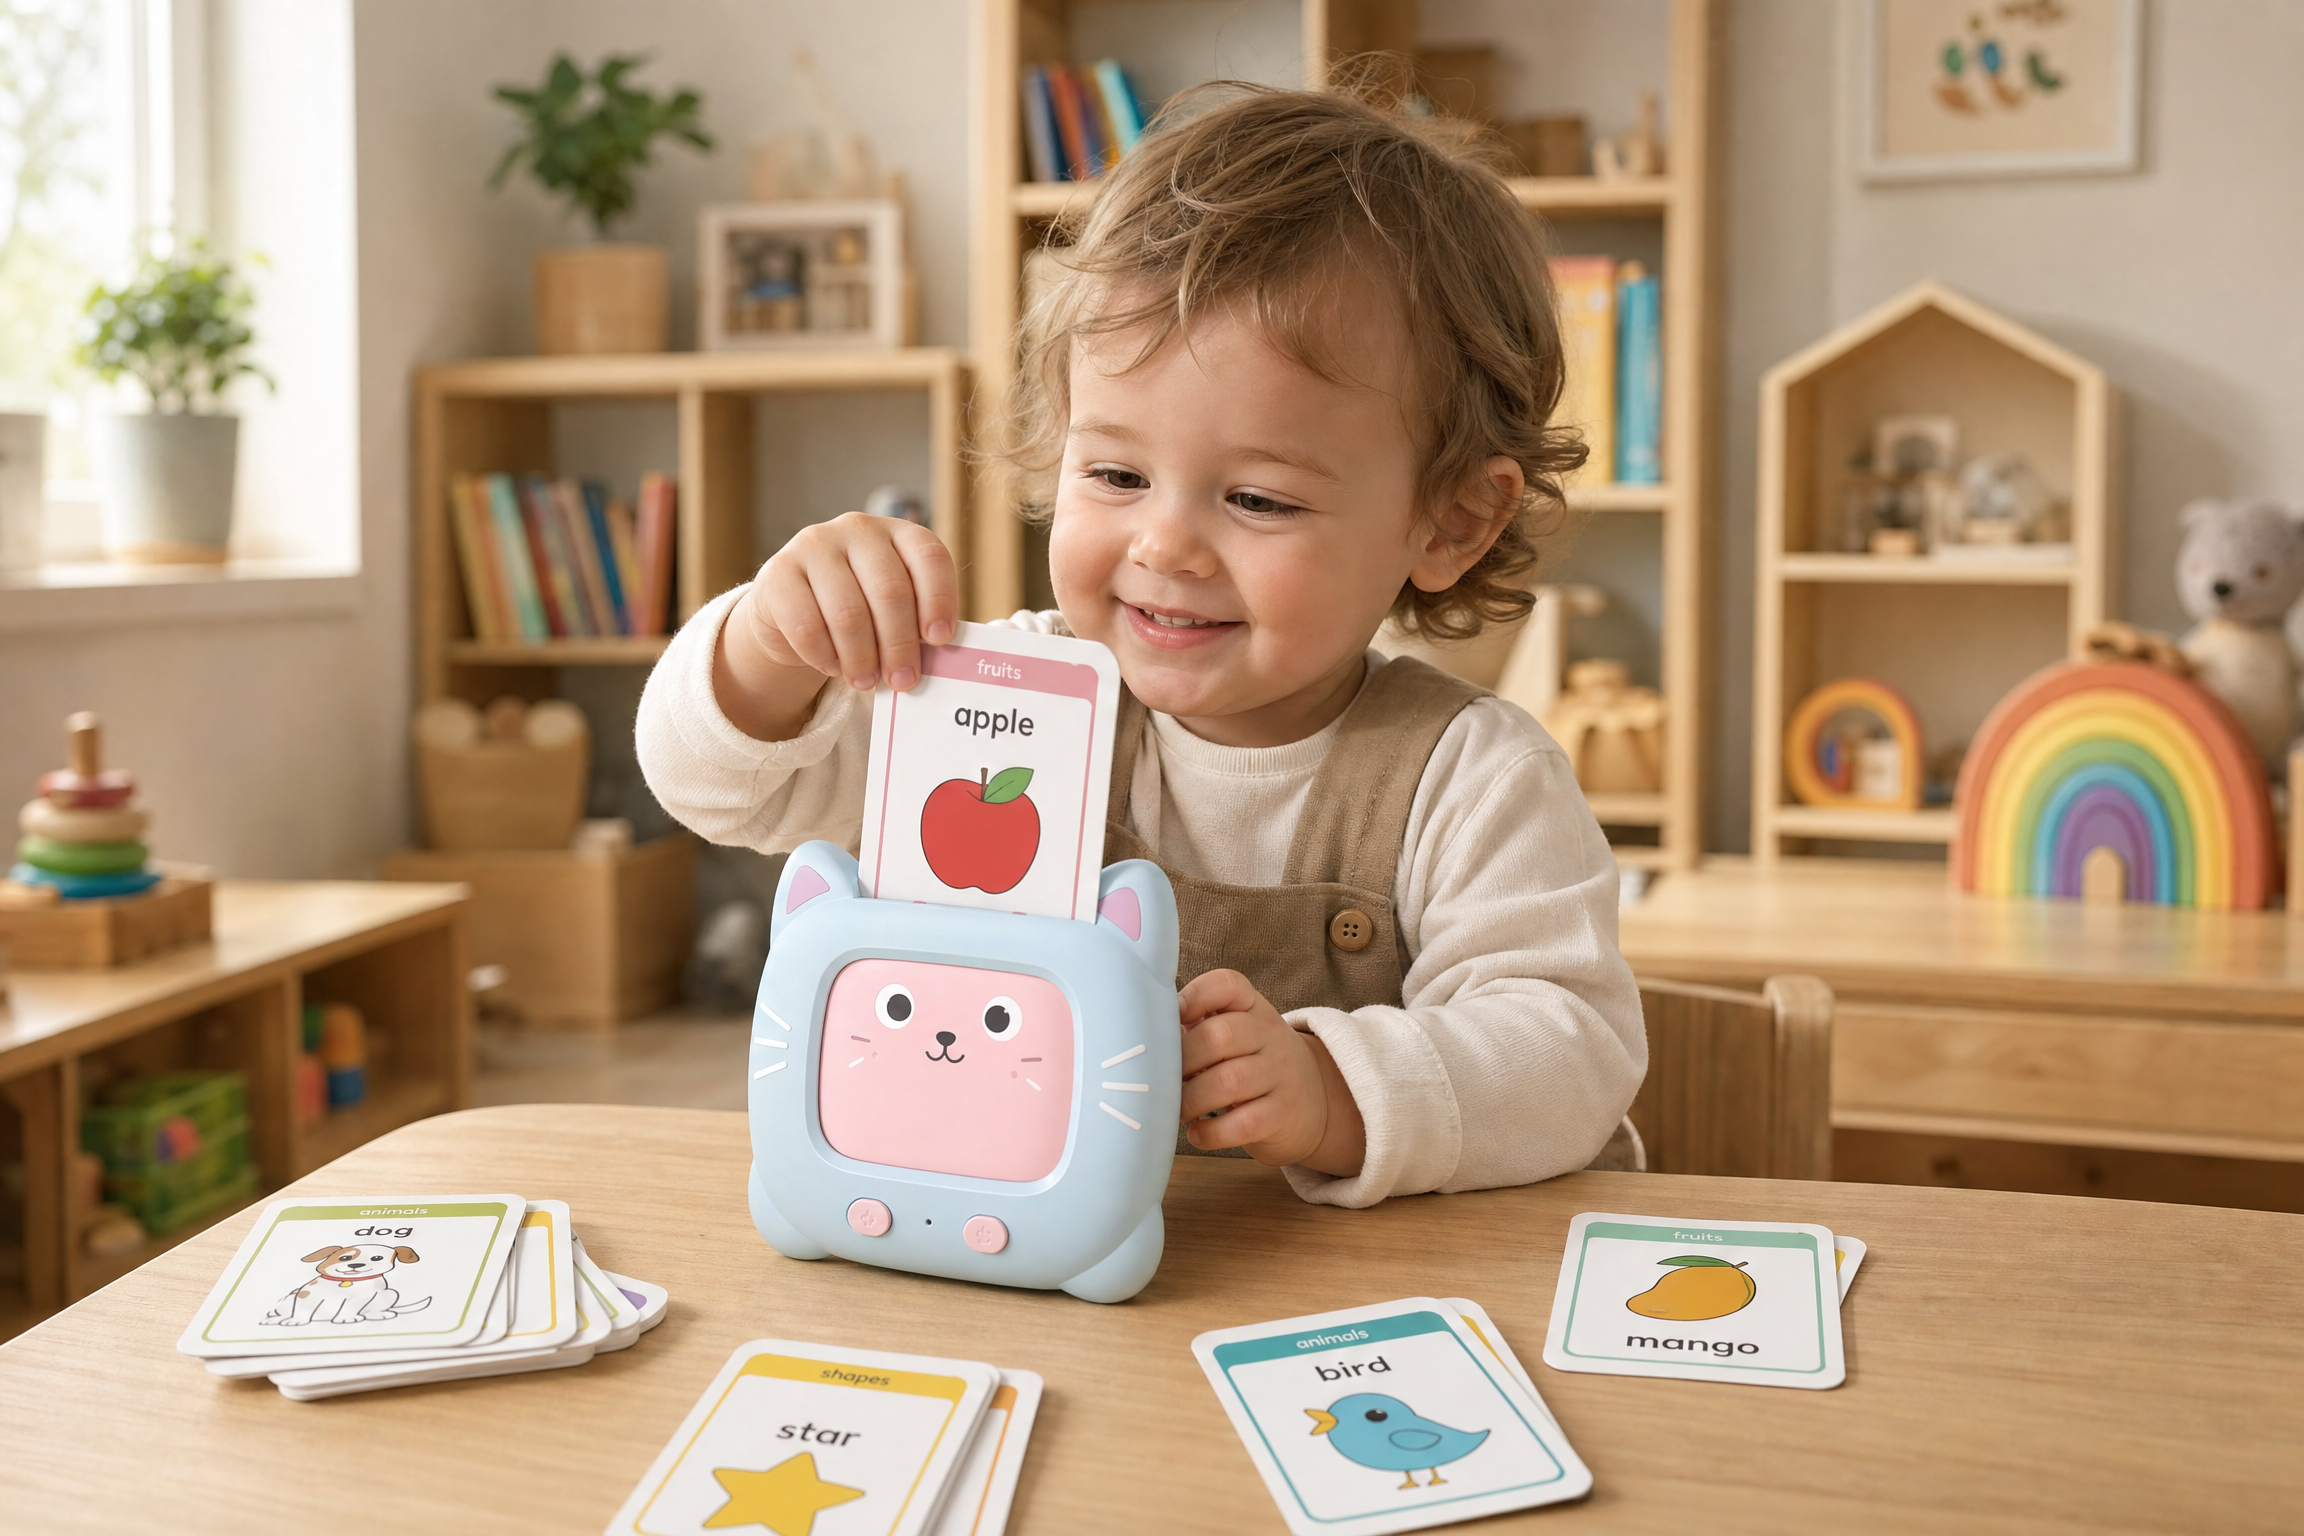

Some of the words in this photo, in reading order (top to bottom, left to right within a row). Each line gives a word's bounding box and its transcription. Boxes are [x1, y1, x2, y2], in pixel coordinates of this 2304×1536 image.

[977, 659, 1022, 680] fruits
[954, 706, 1034, 739] apple
[359, 1207, 428, 1216] animals
[354, 1225, 413, 1239] dog
[1672, 1231, 1723, 1243] fruits
[1296, 1328, 1370, 1350] animals
[1626, 1335, 1760, 1357] mango
[820, 1368, 891, 1387] shapes
[1315, 1355, 1392, 1382] bird
[776, 1422, 861, 1447] star
